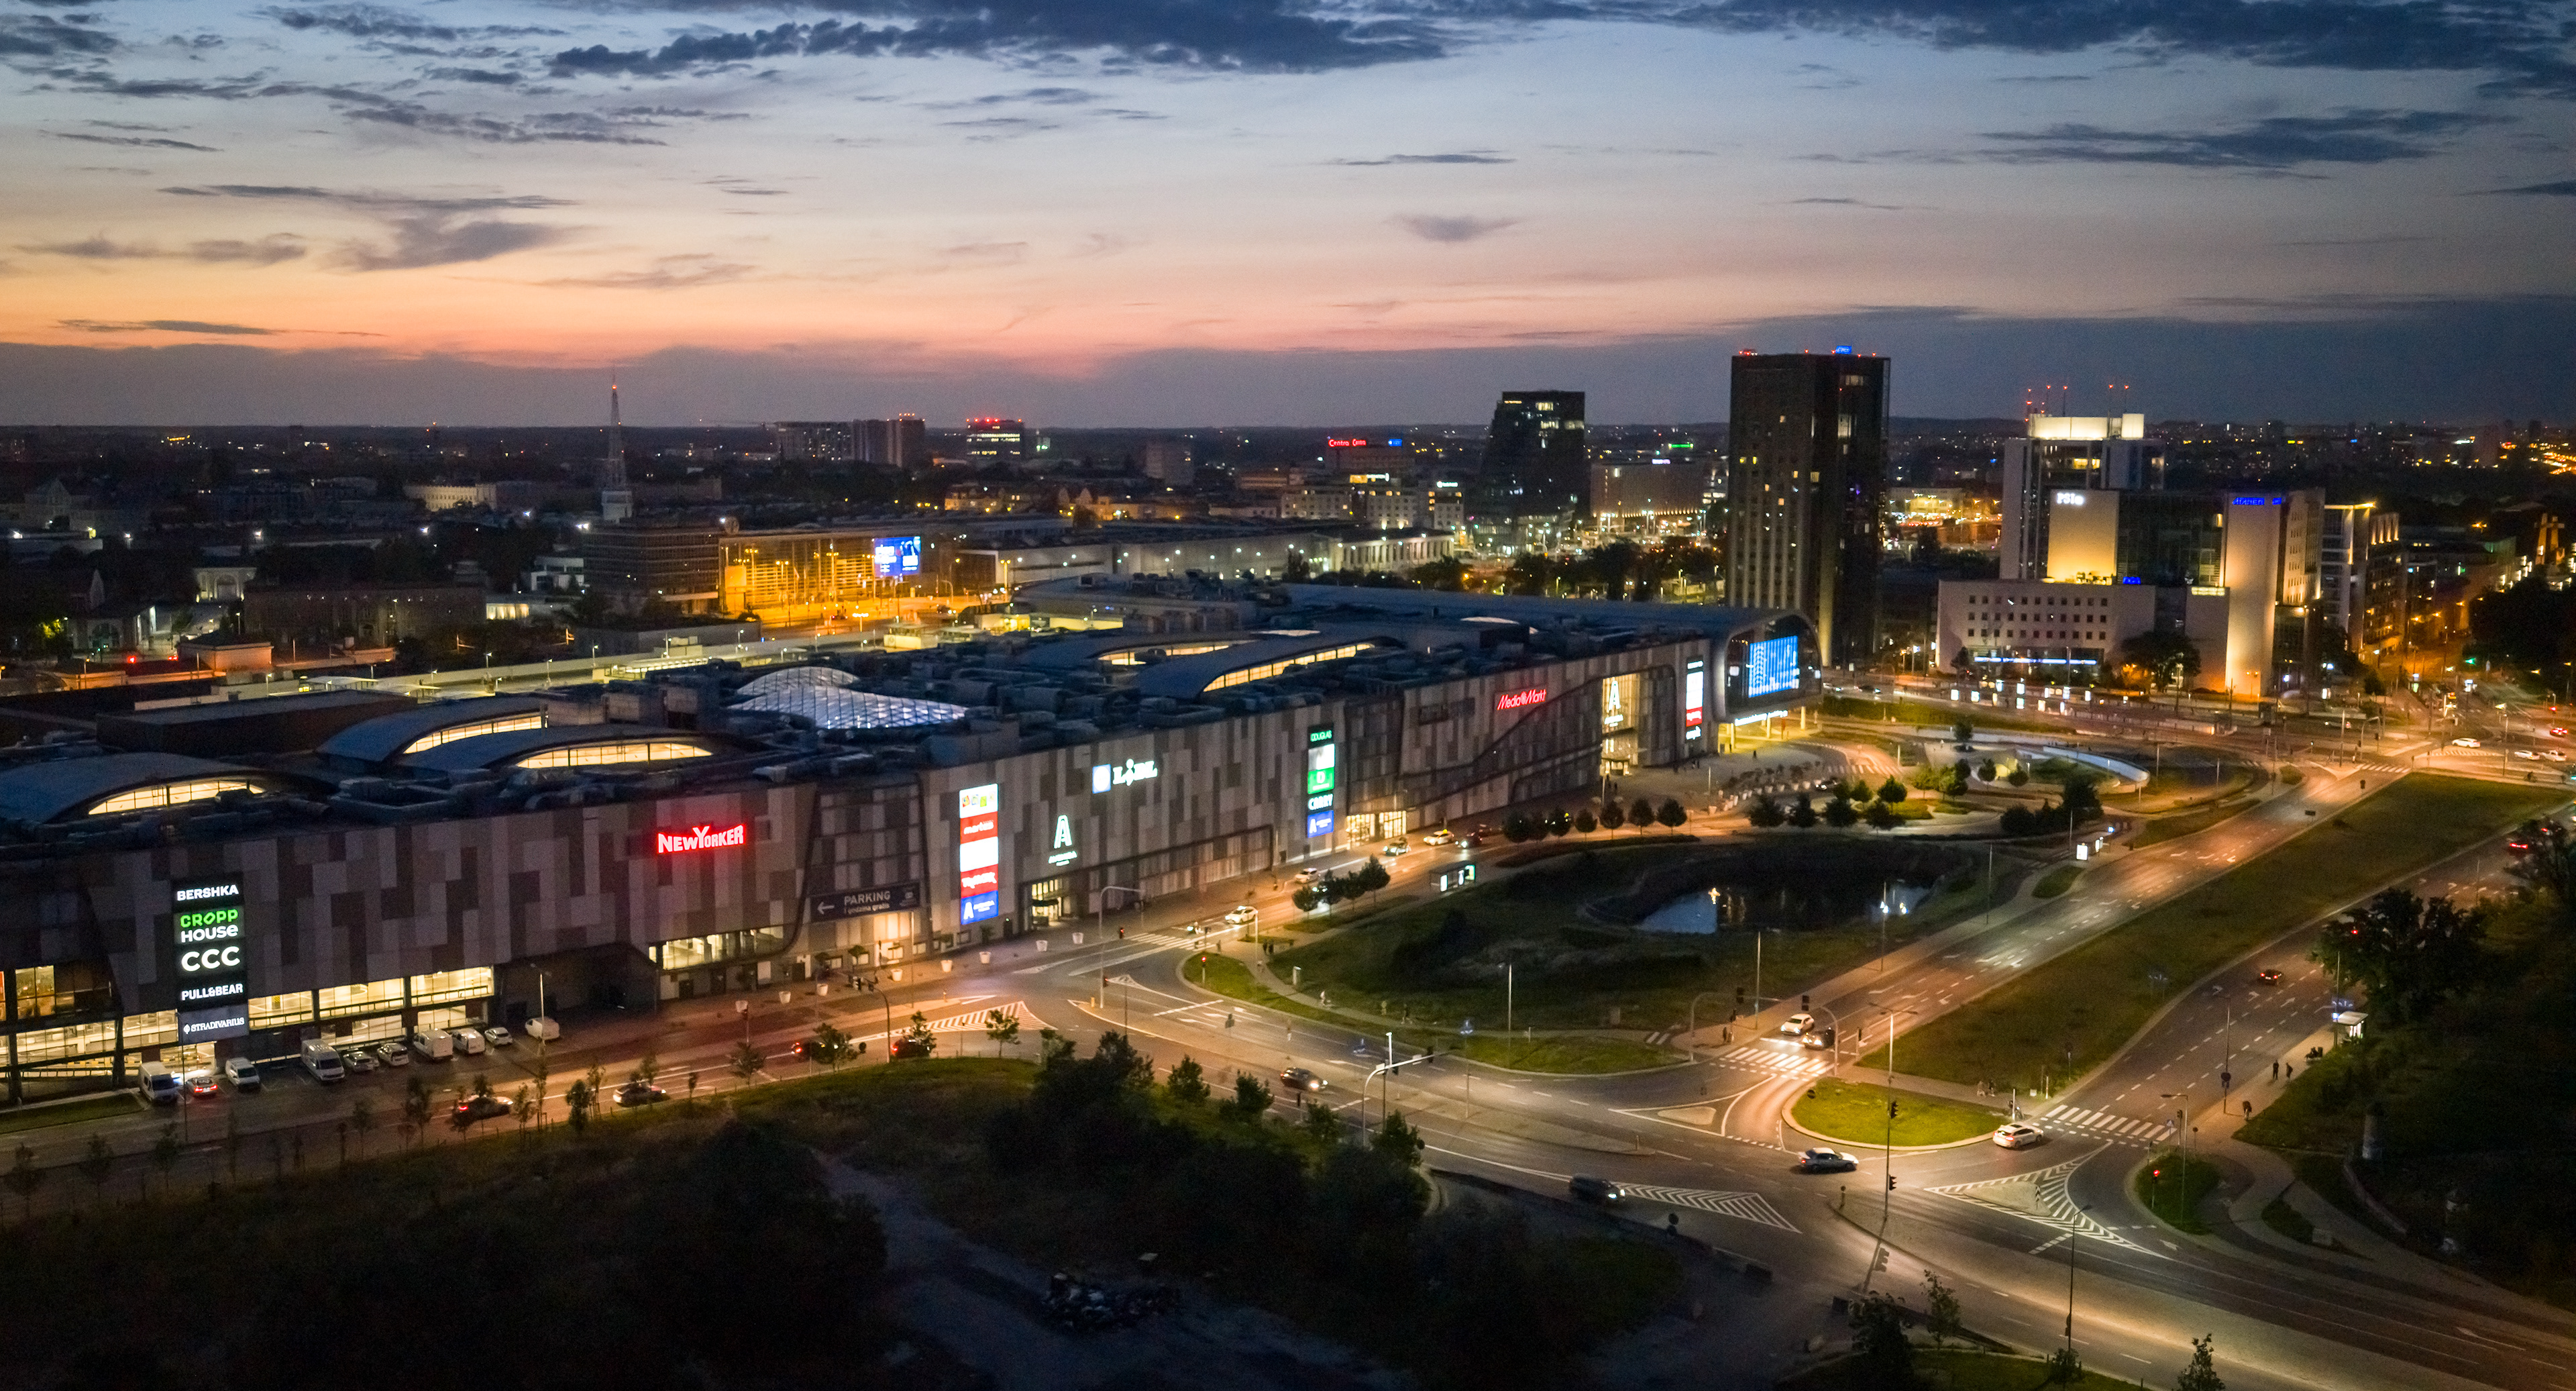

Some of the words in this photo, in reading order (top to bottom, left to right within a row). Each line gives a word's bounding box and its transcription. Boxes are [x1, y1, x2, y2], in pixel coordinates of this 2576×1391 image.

[176, 884, 239, 901] BERSHKA
[844, 890, 891, 906] PARKING
[180, 909, 239, 928] CROPP
[181, 946, 241, 972] CCC
[181, 983, 244, 1001] PULL&BEAR
[191, 1017, 246, 1033] STRADIVARIUS
